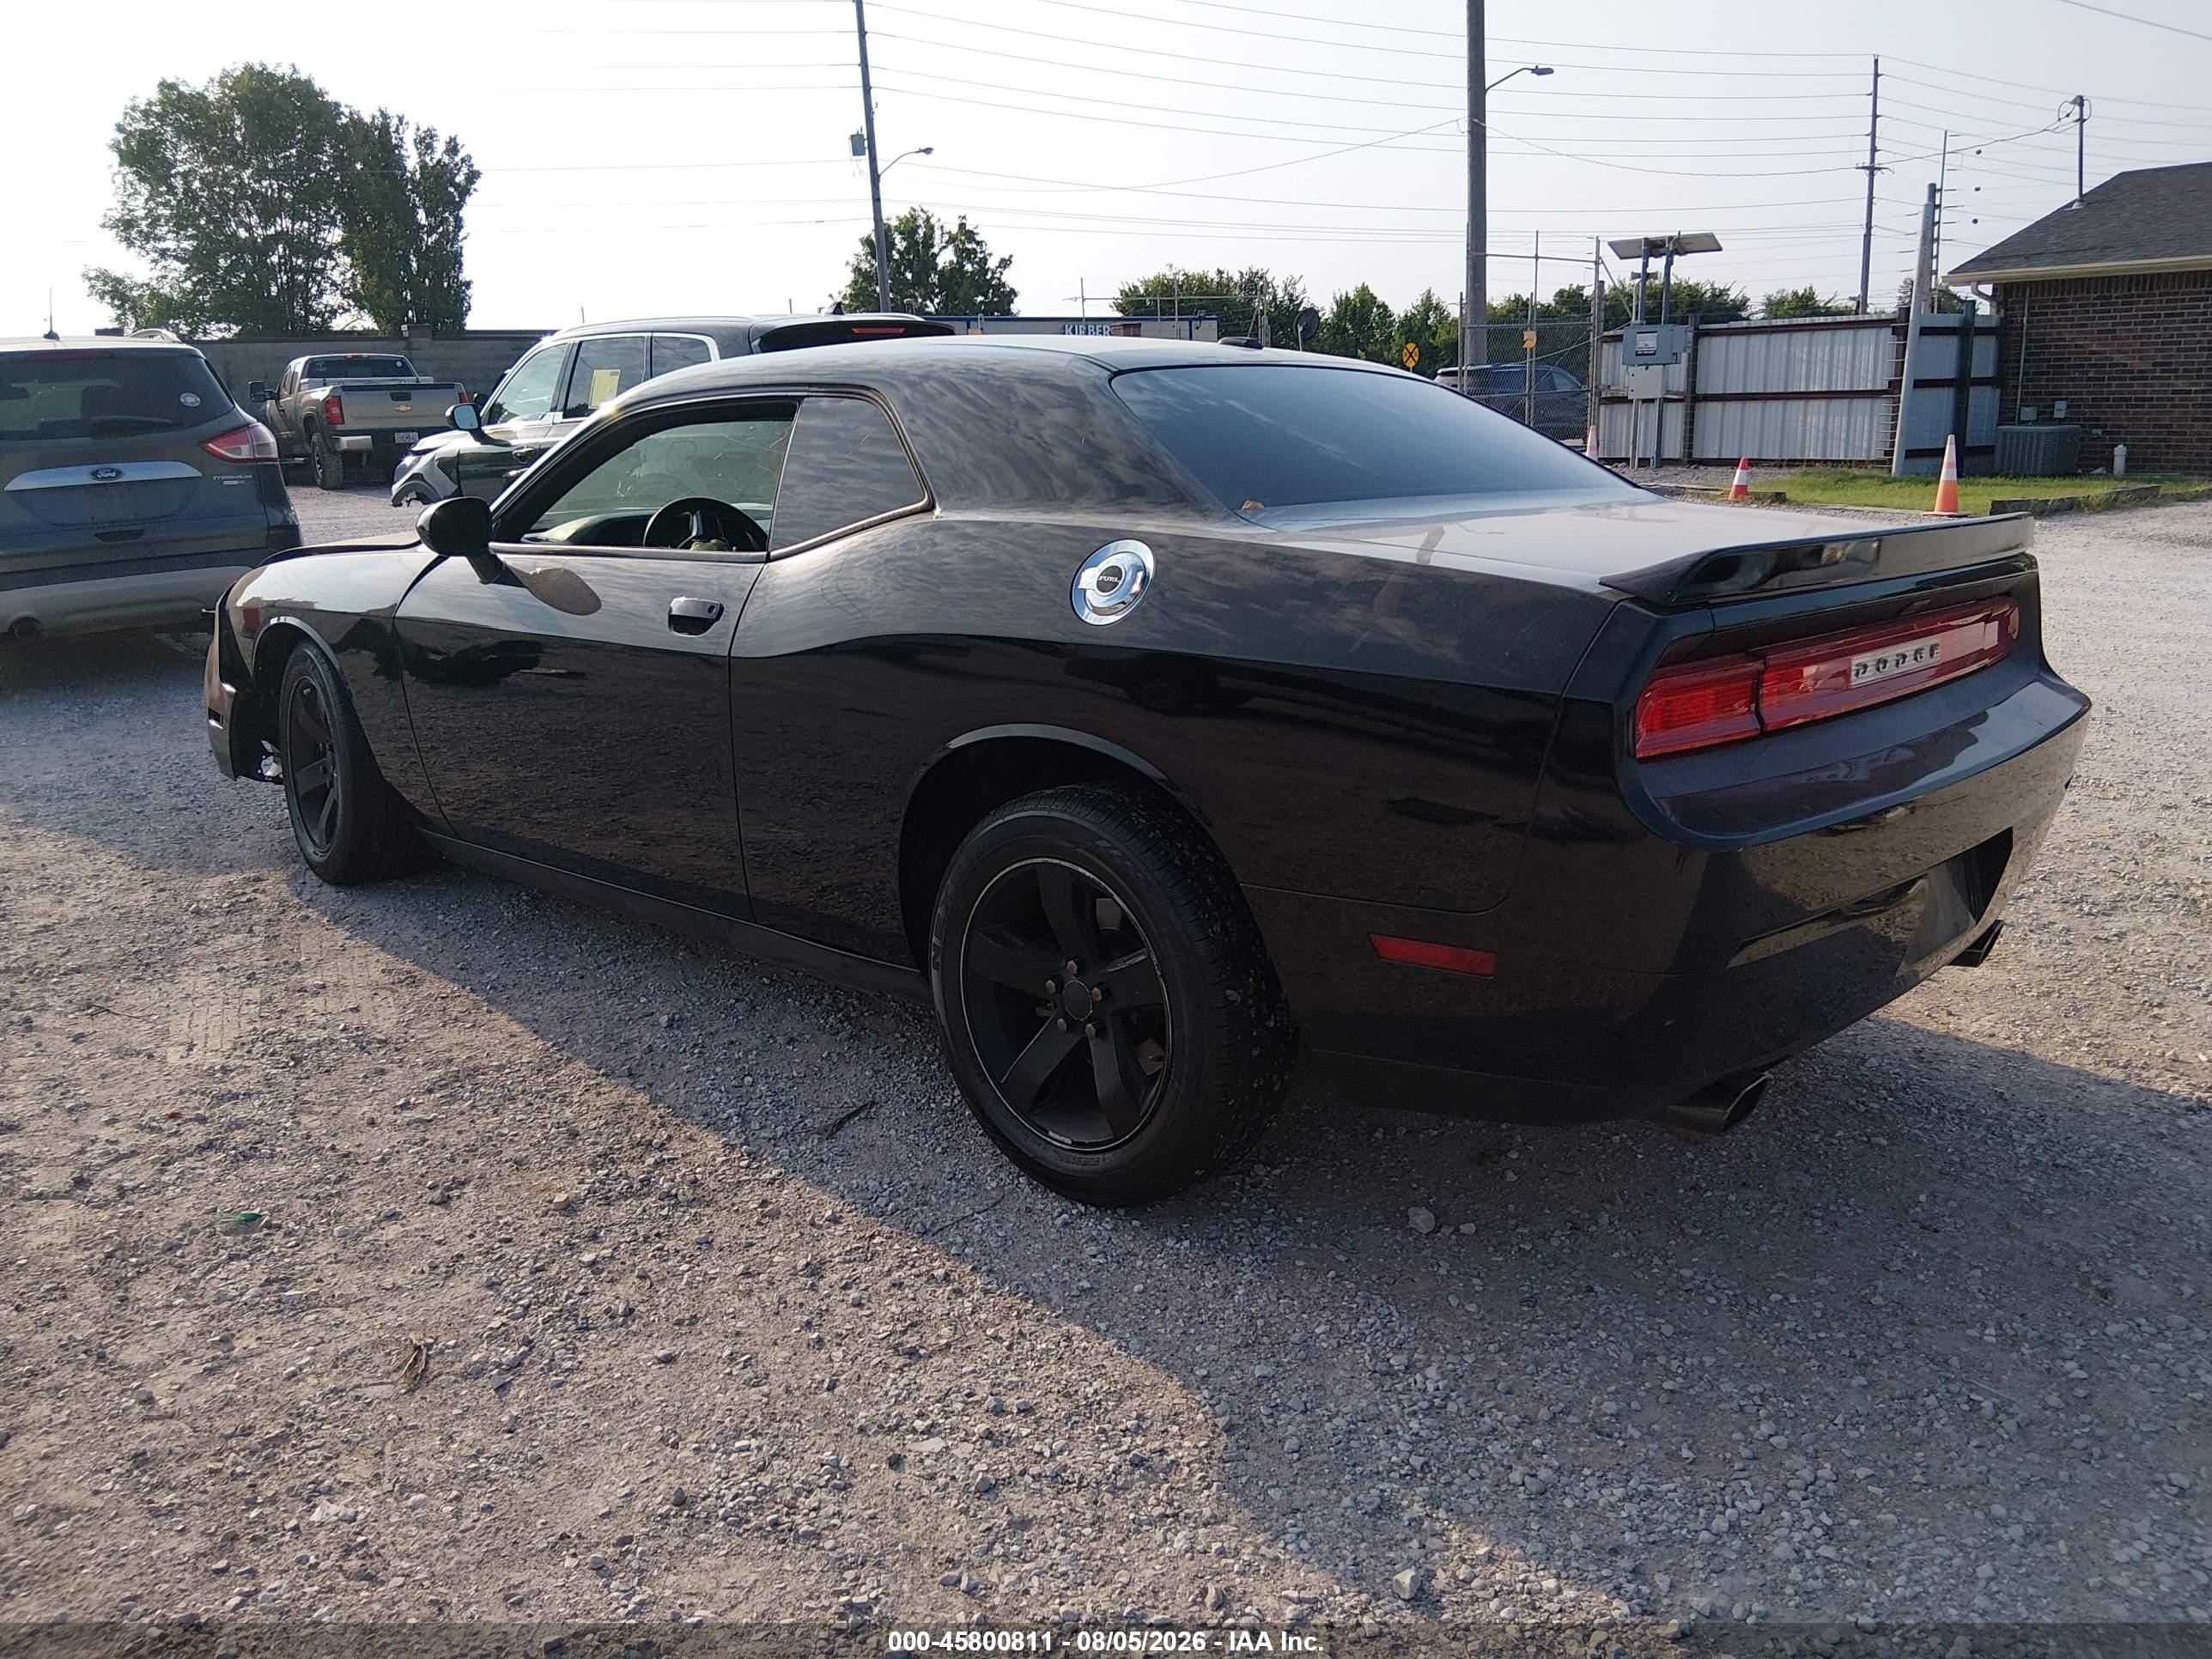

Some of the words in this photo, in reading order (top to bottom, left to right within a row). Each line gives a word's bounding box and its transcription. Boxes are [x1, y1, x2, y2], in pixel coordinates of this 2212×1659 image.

[1065, 323, 1115, 337] KIRBER
[96, 469, 117, 478] Ford
[1098, 574, 1120, 583] FUEL
[1854, 642, 1941, 678] DODGE
